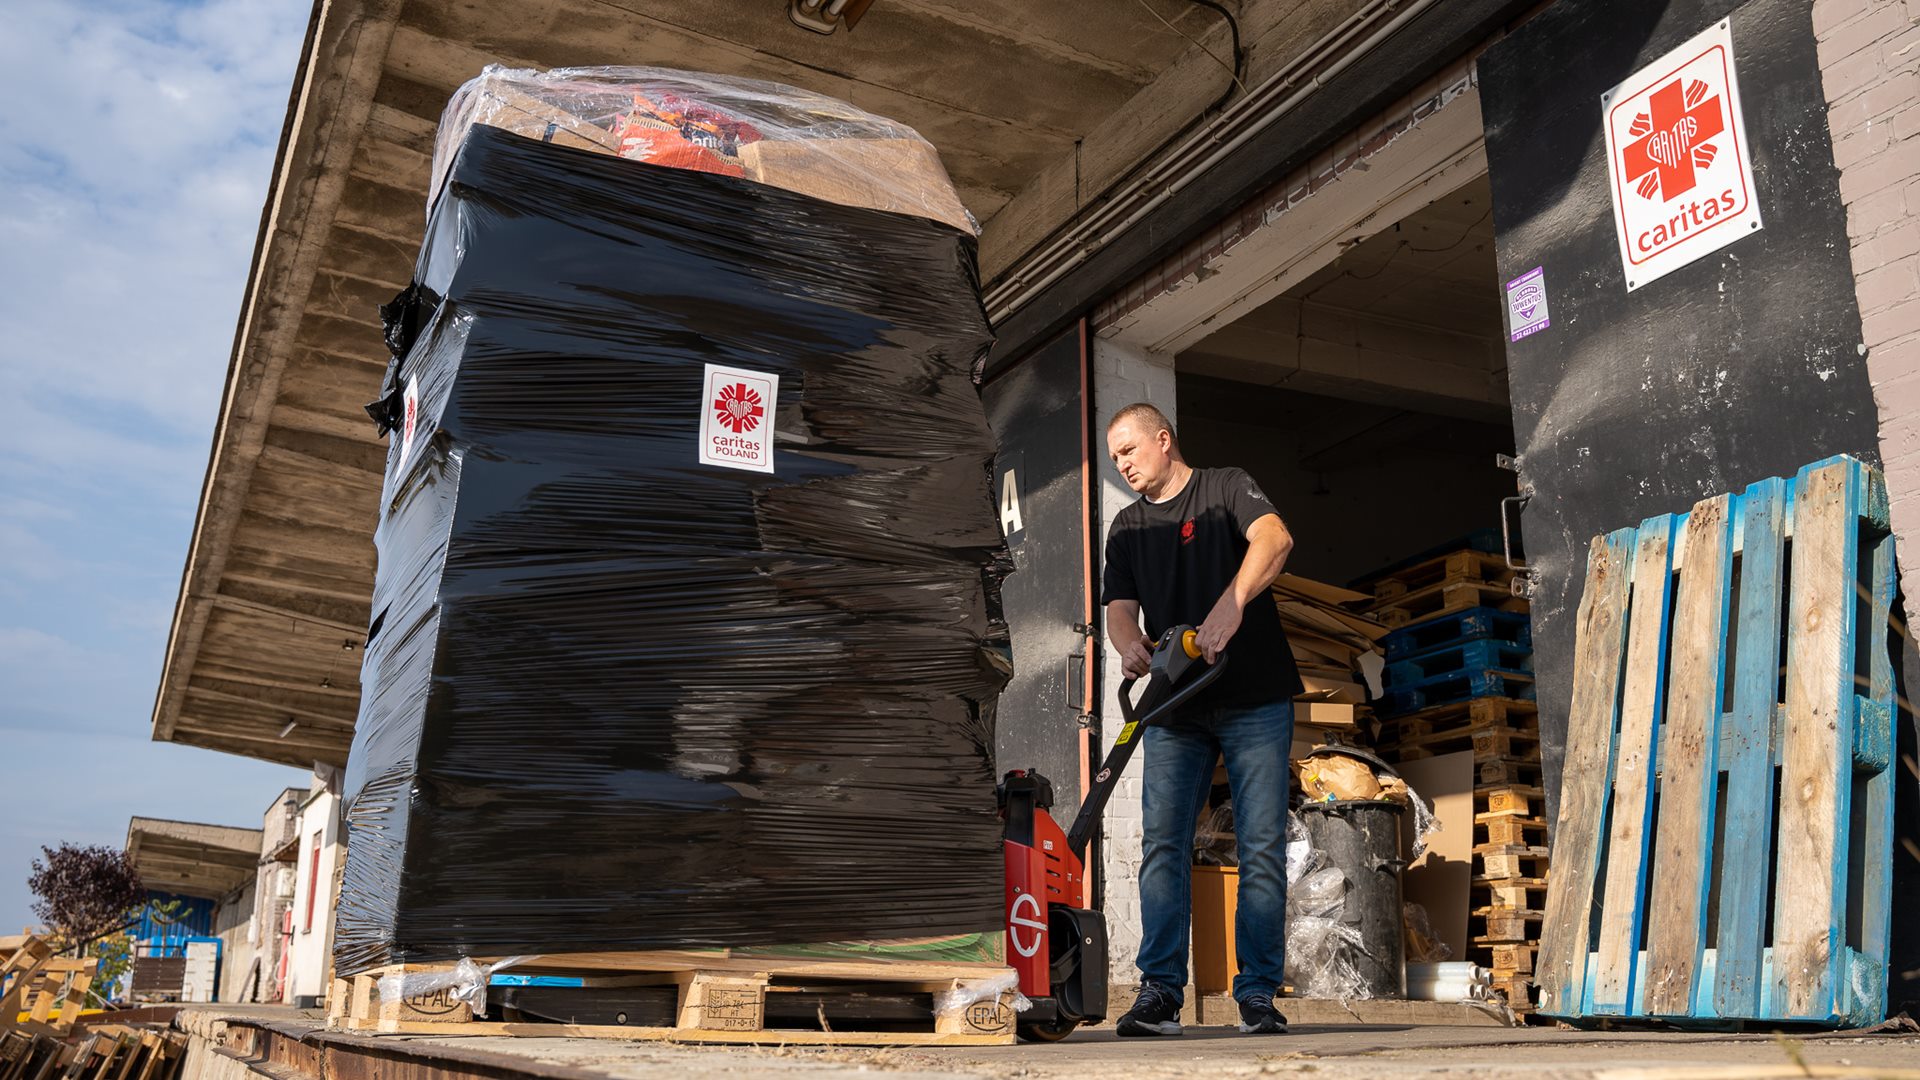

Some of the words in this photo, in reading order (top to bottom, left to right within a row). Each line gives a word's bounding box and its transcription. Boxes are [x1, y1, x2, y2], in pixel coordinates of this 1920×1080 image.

[1647, 116, 1697, 168] CARITAS
[1637, 188, 1736, 253] caritas
[726, 399, 752, 420] CARITAS
[713, 436, 760, 451] caritas
[715, 446, 759, 460] POLAND
[1001, 469, 1024, 537] A
[973, 1007, 1005, 1025] EPAL
